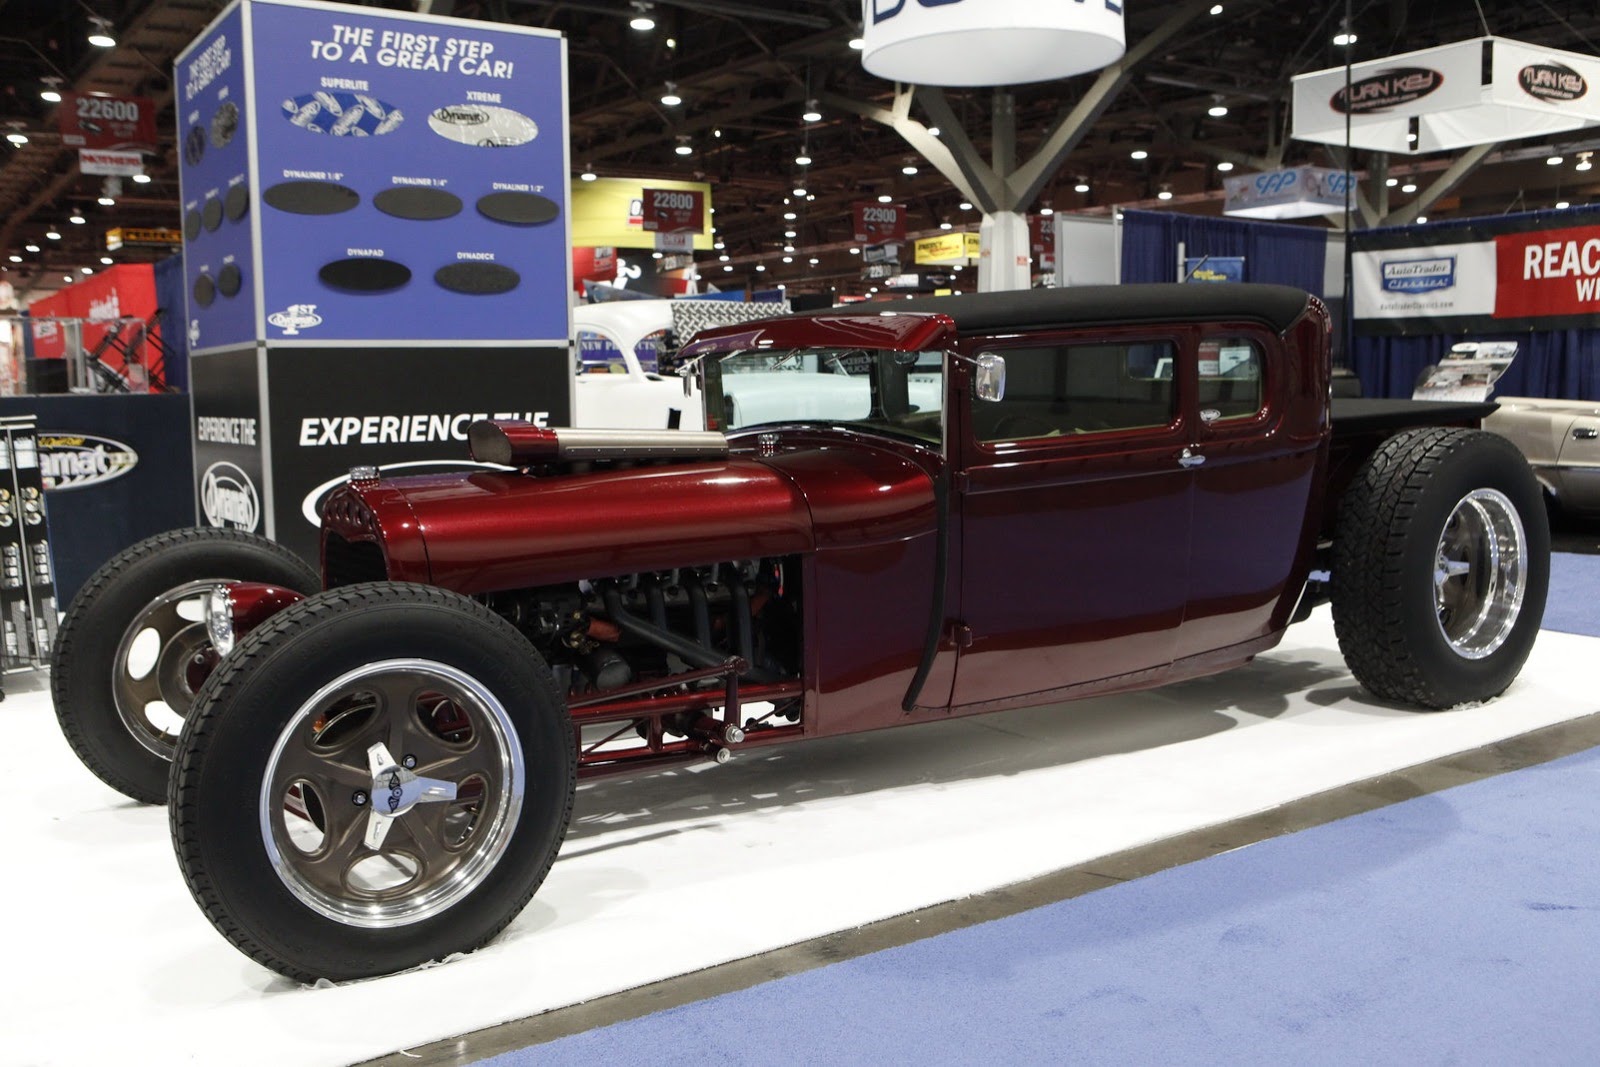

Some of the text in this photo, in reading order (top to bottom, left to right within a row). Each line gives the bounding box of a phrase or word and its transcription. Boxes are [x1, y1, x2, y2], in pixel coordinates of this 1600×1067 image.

[333, 24, 494, 60] THE FIRST STEP
[310, 40, 514, 80] TO A GREAT CAR!
[320, 76, 369, 91] SUPERLITE
[466, 90, 502, 104] XTREME
[76, 97, 139, 122] 22600
[283, 169, 326, 180] DYNALINER
[392, 175, 431, 186] DYNALINER
[493, 182, 529, 192] DYNALINER
[653, 191, 694, 210] 22800
[863, 207, 897, 223] 22900
[347, 248, 384, 257] DYNAPAD
[457, 251, 494, 261] DYNADECK
[1523, 238, 1600, 281] REAC
[1388, 263, 1447, 276] AutoTrader
[299, 413, 489, 446] EXPERIENC
